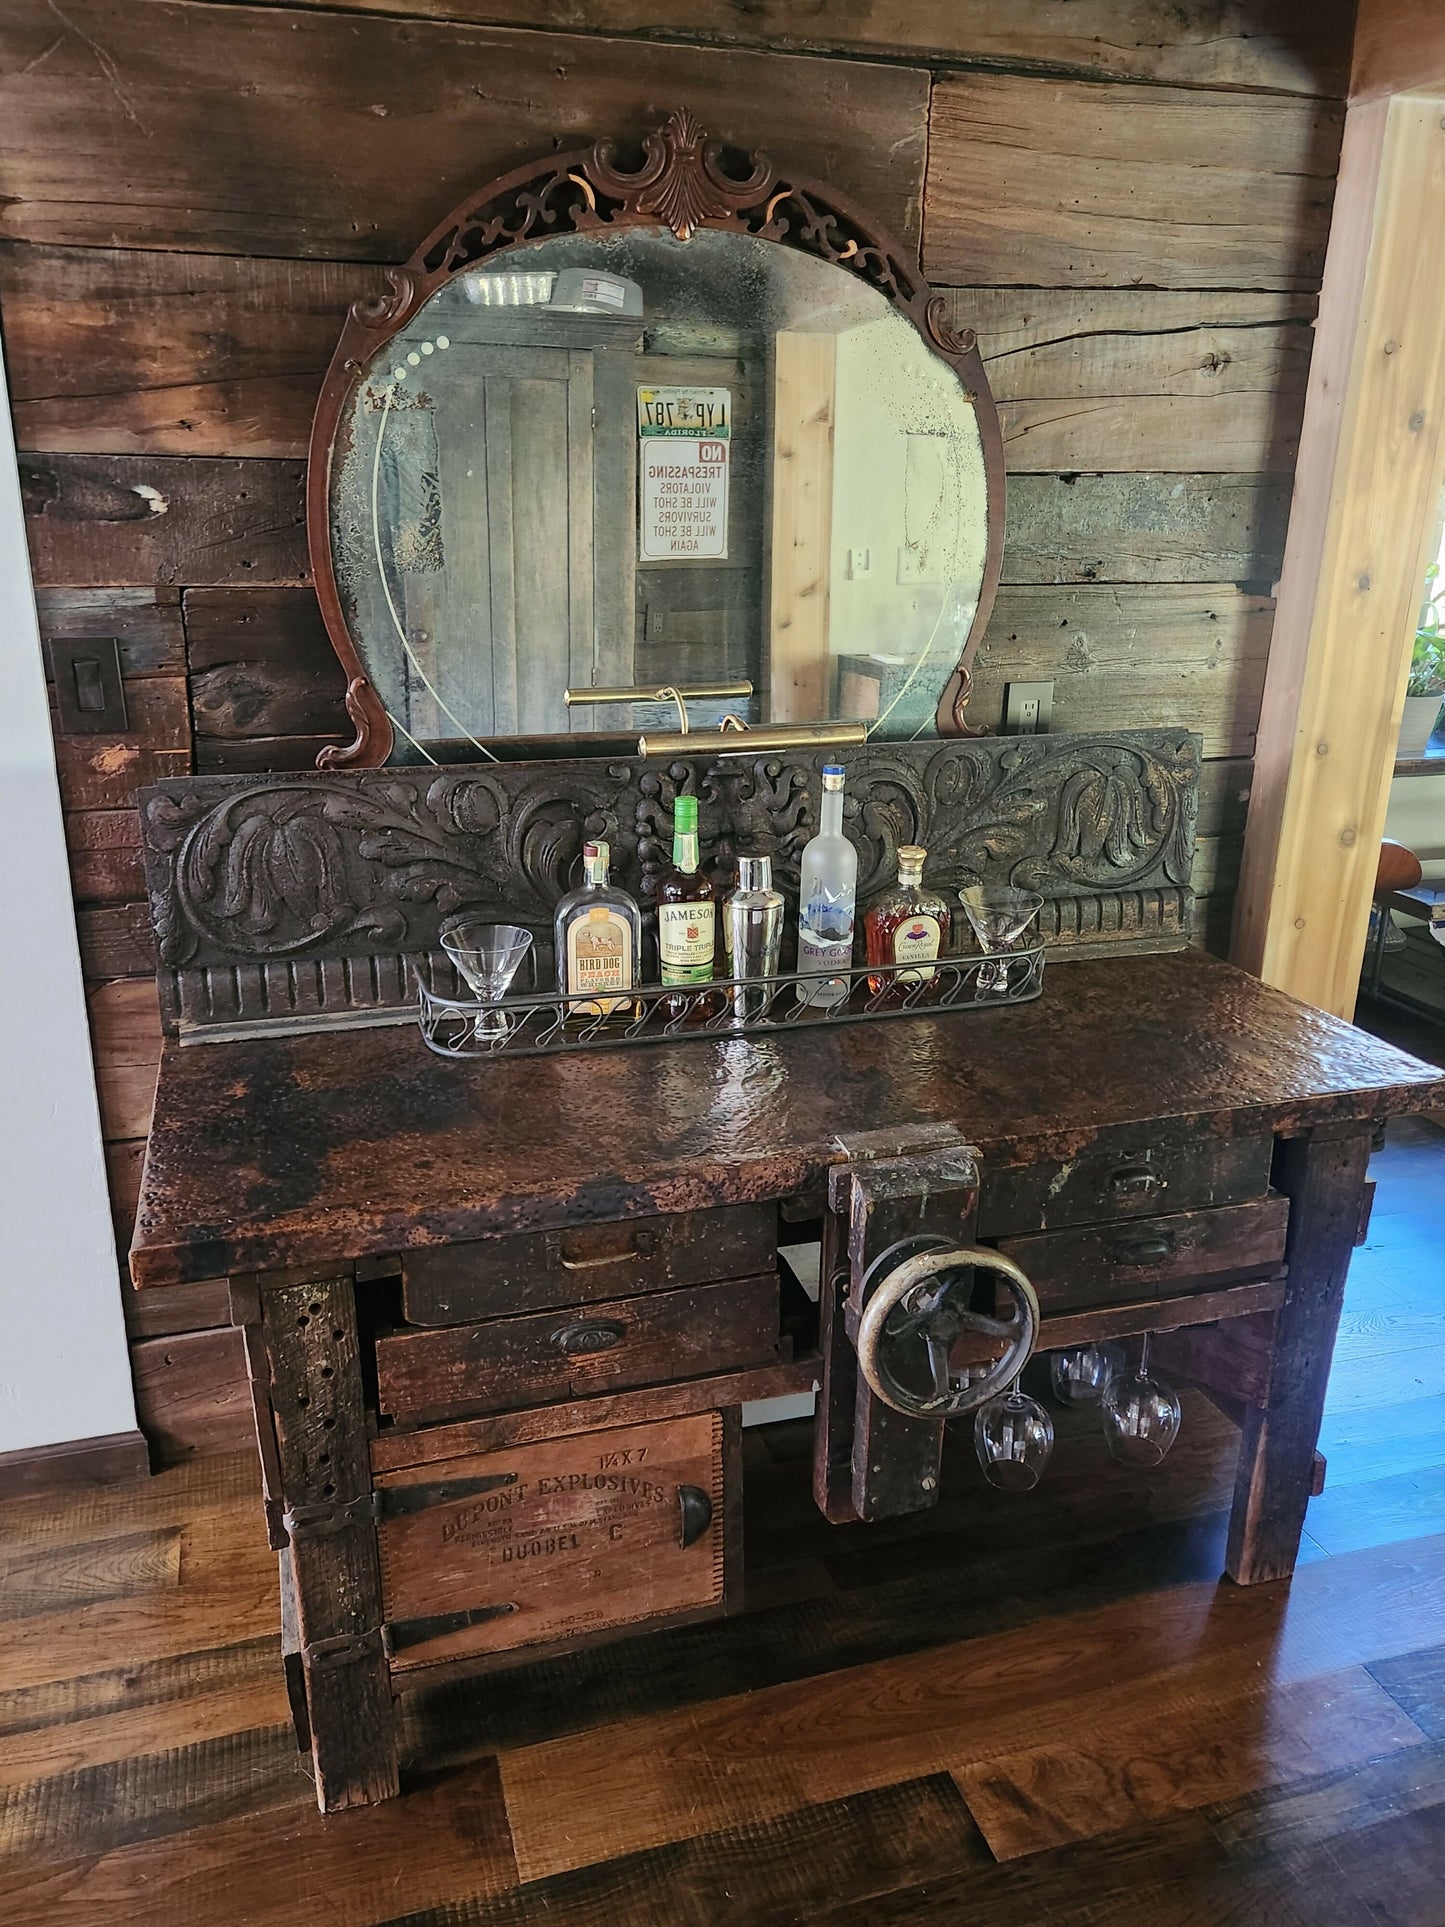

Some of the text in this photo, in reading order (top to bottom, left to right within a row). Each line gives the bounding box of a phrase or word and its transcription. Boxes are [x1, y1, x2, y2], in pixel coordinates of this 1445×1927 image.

[664, 908, 713, 922] JAMESON
[665, 943, 692, 952] TRIPLE
[694, 941, 714, 952] TRIPL
[803, 946, 827, 957] GREY
[579, 957, 620, 970] BIRD DOG
[580, 970, 620, 979] PEACH
[538, 1473, 664, 1503] EXPLOSIVES
